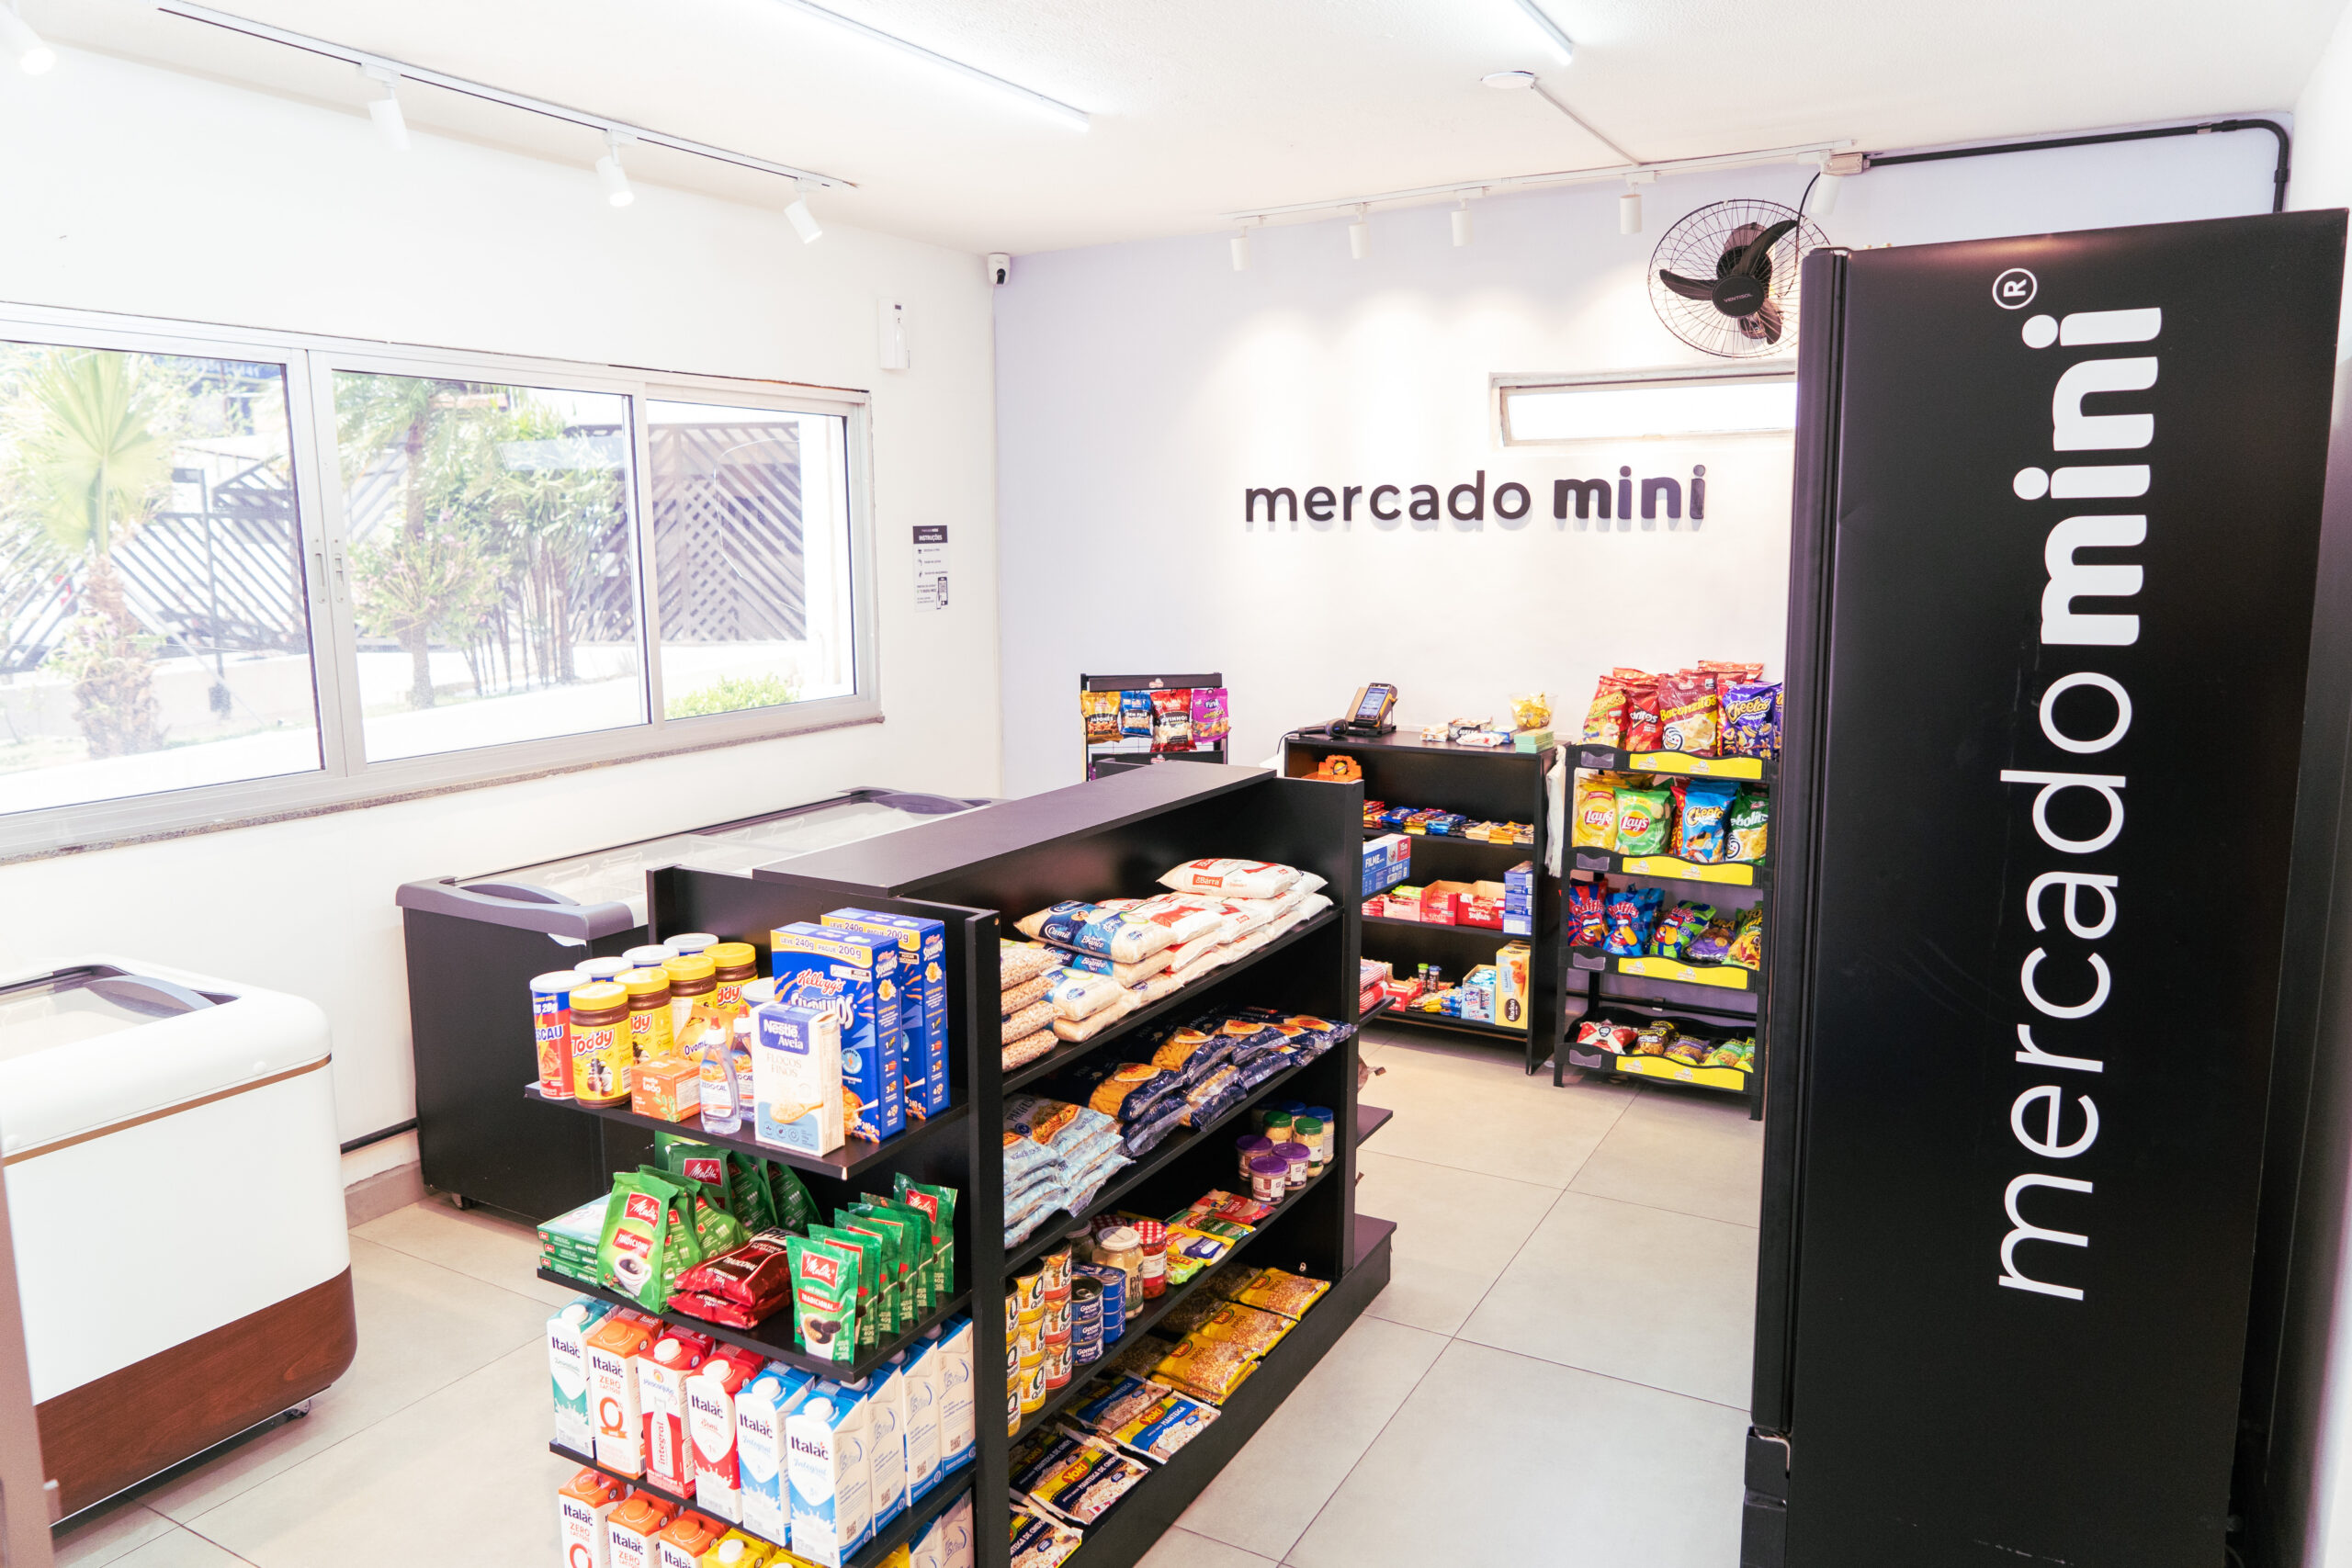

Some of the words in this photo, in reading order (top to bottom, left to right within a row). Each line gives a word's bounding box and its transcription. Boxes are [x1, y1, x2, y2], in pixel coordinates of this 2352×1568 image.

[2012, 307, 2162, 647] mini
[1245, 469, 1532, 523] mercado
[1553, 464, 1706, 521] mini
[1659, 694, 1717, 722] Baconzitos
[1726, 696, 1771, 724] Cheetos
[1687, 806, 1724, 826] Cheeto
[1200, 876, 1220, 886] Barra
[887, 929, 910, 943] 200g
[1048, 926, 1070, 939] Camil
[1080, 935, 1104, 948] Branco
[795, 937, 814, 951] 240g
[838, 944, 862, 959] 200g
[797, 969, 845, 995] Kellogg's
[1998, 671, 2132, 1301] mercado
[536, 1025, 563, 1041] SCAU
[572, 1029, 615, 1055] Toddy
[778, 1035, 804, 1050] Aveia
[766, 1052, 802, 1068] FLOCOS
[771, 1064, 798, 1077] FINOS
[552, 1336, 581, 1359] Italac
[593, 1355, 624, 1378] Italac
[599, 1374, 621, 1390] ZERO
[691, 1394, 724, 1419] Italac
[1140, 1407, 1163, 1424] Yoki
[740, 1413, 774, 1439] Italac
[658, 1420, 666, 1465] integral
[790, 1436, 829, 1461] Italac
[1063, 1462, 1088, 1481] Yoki
[563, 1504, 594, 1527] Italac
[570, 1521, 591, 1537] ZERO
[612, 1531, 644, 1555] Italac
[618, 1551, 640, 1566] ZERO
